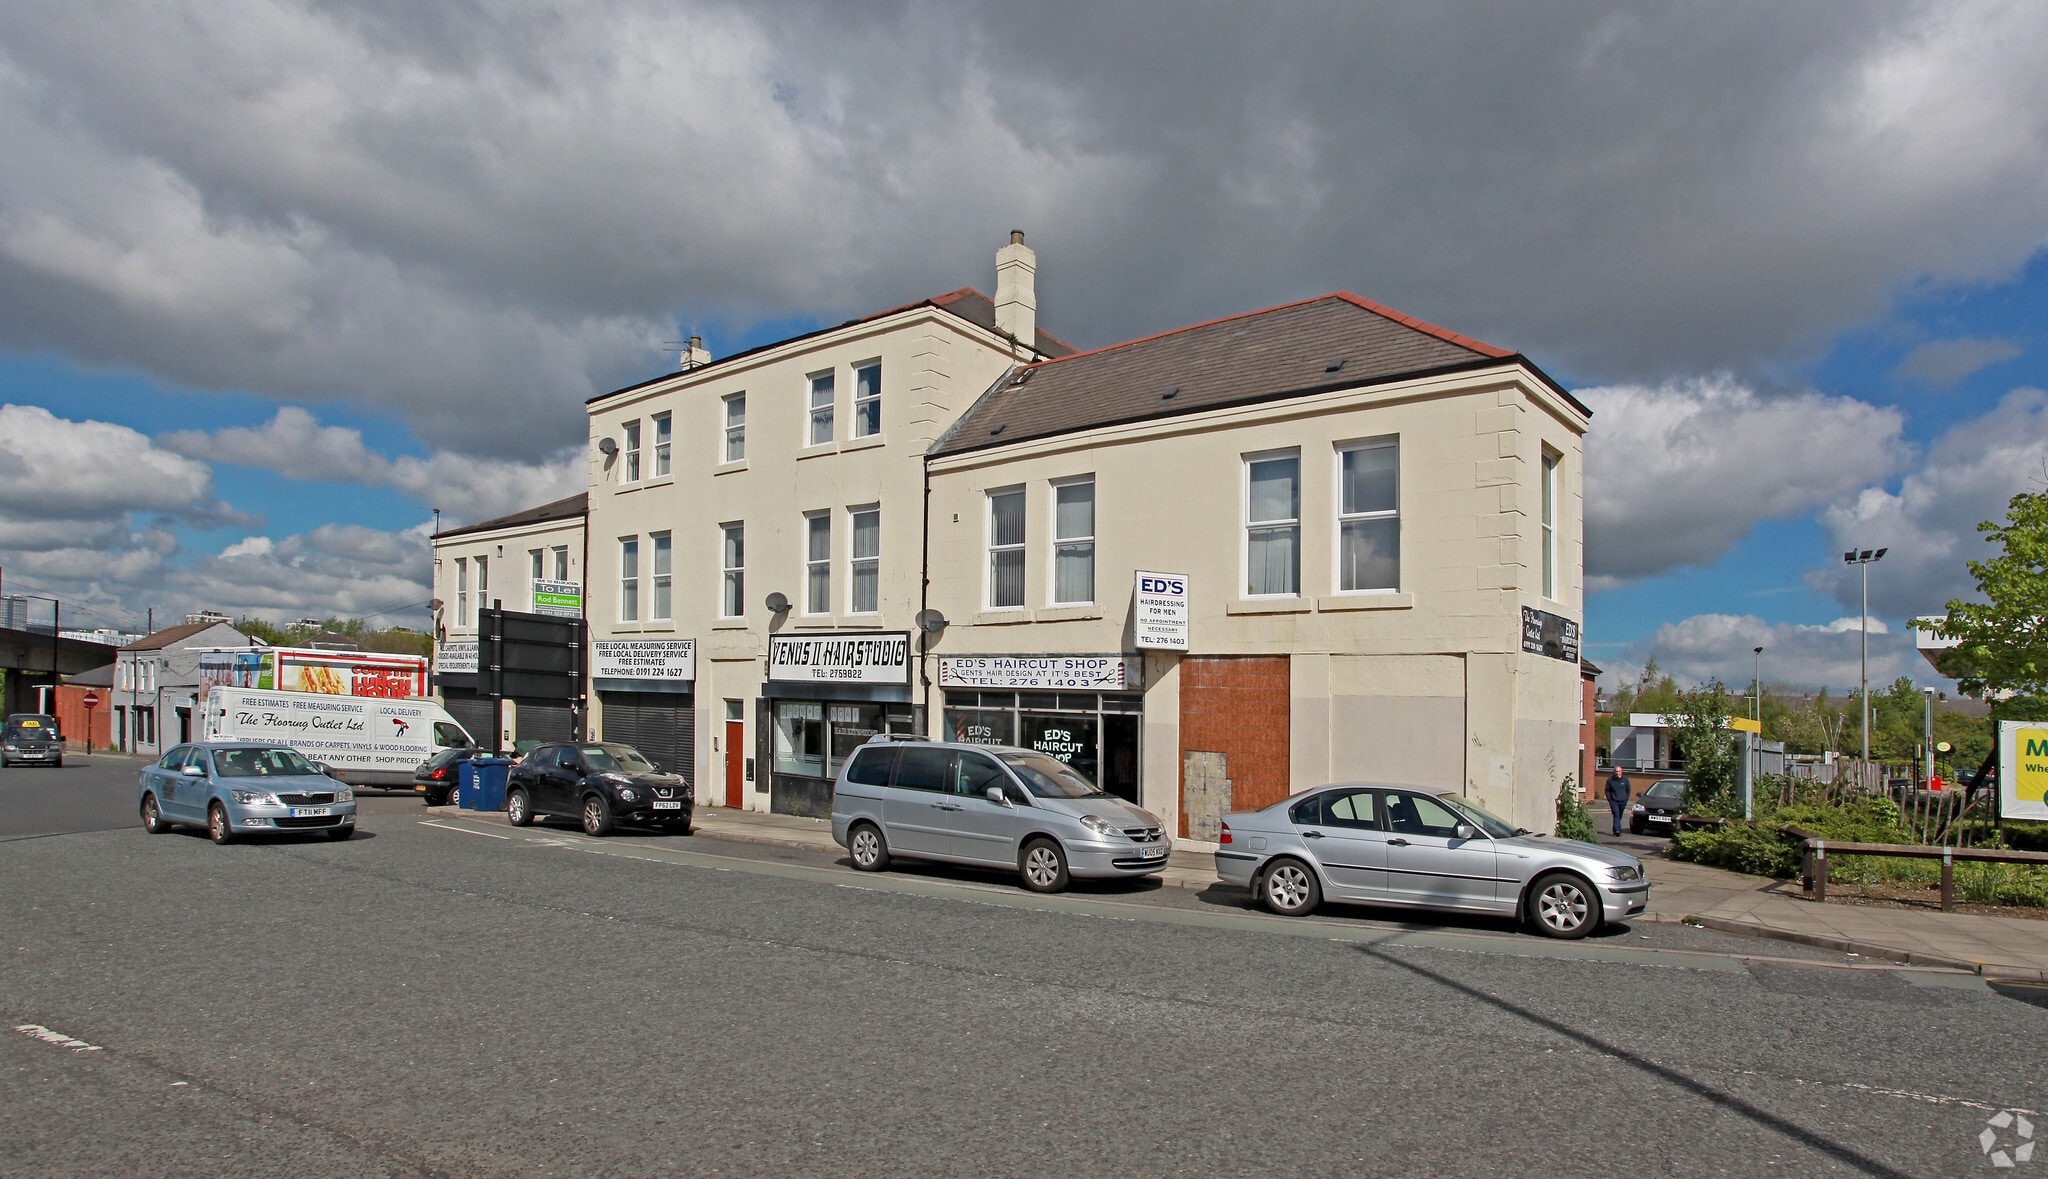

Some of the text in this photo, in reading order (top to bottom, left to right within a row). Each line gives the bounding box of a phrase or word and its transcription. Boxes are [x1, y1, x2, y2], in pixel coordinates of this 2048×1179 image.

[540, 584, 554, 592] To
[1141, 578, 1184, 594] ED'S
[552, 597, 578, 605] Bennett
[1140, 598, 1184, 608] HAIRDRESSING
[772, 641, 812, 666] VENUS
[956, 660, 1108, 669] ED'S HAIRCUT SHOP
[636, 668, 650, 676] 0191
[652, 668, 664, 676] 224
[666, 668, 682, 676] 1627
[812, 668, 828, 678] TEL:
[352, 676, 412, 688] LUNCH
[1047, 679, 1090, 687] 1403
[242, 698, 290, 708] FREE ESTIMATES
[292, 701, 363, 713] FREE MEASURING SERVICE
[380, 707, 422, 716] LOCAL DELIVERY
[236, 712, 259, 726] The
[262, 712, 309, 731] Flooring
[312, 716, 344, 730] Outlet
[346, 718, 364, 730] Ltd
[968, 726, 992, 736] ED'S
[1044, 729, 1071, 742] ED'S
[289, 740, 314, 748] BRANDS
[1033, 740, 1084, 753] HAIRCUT
